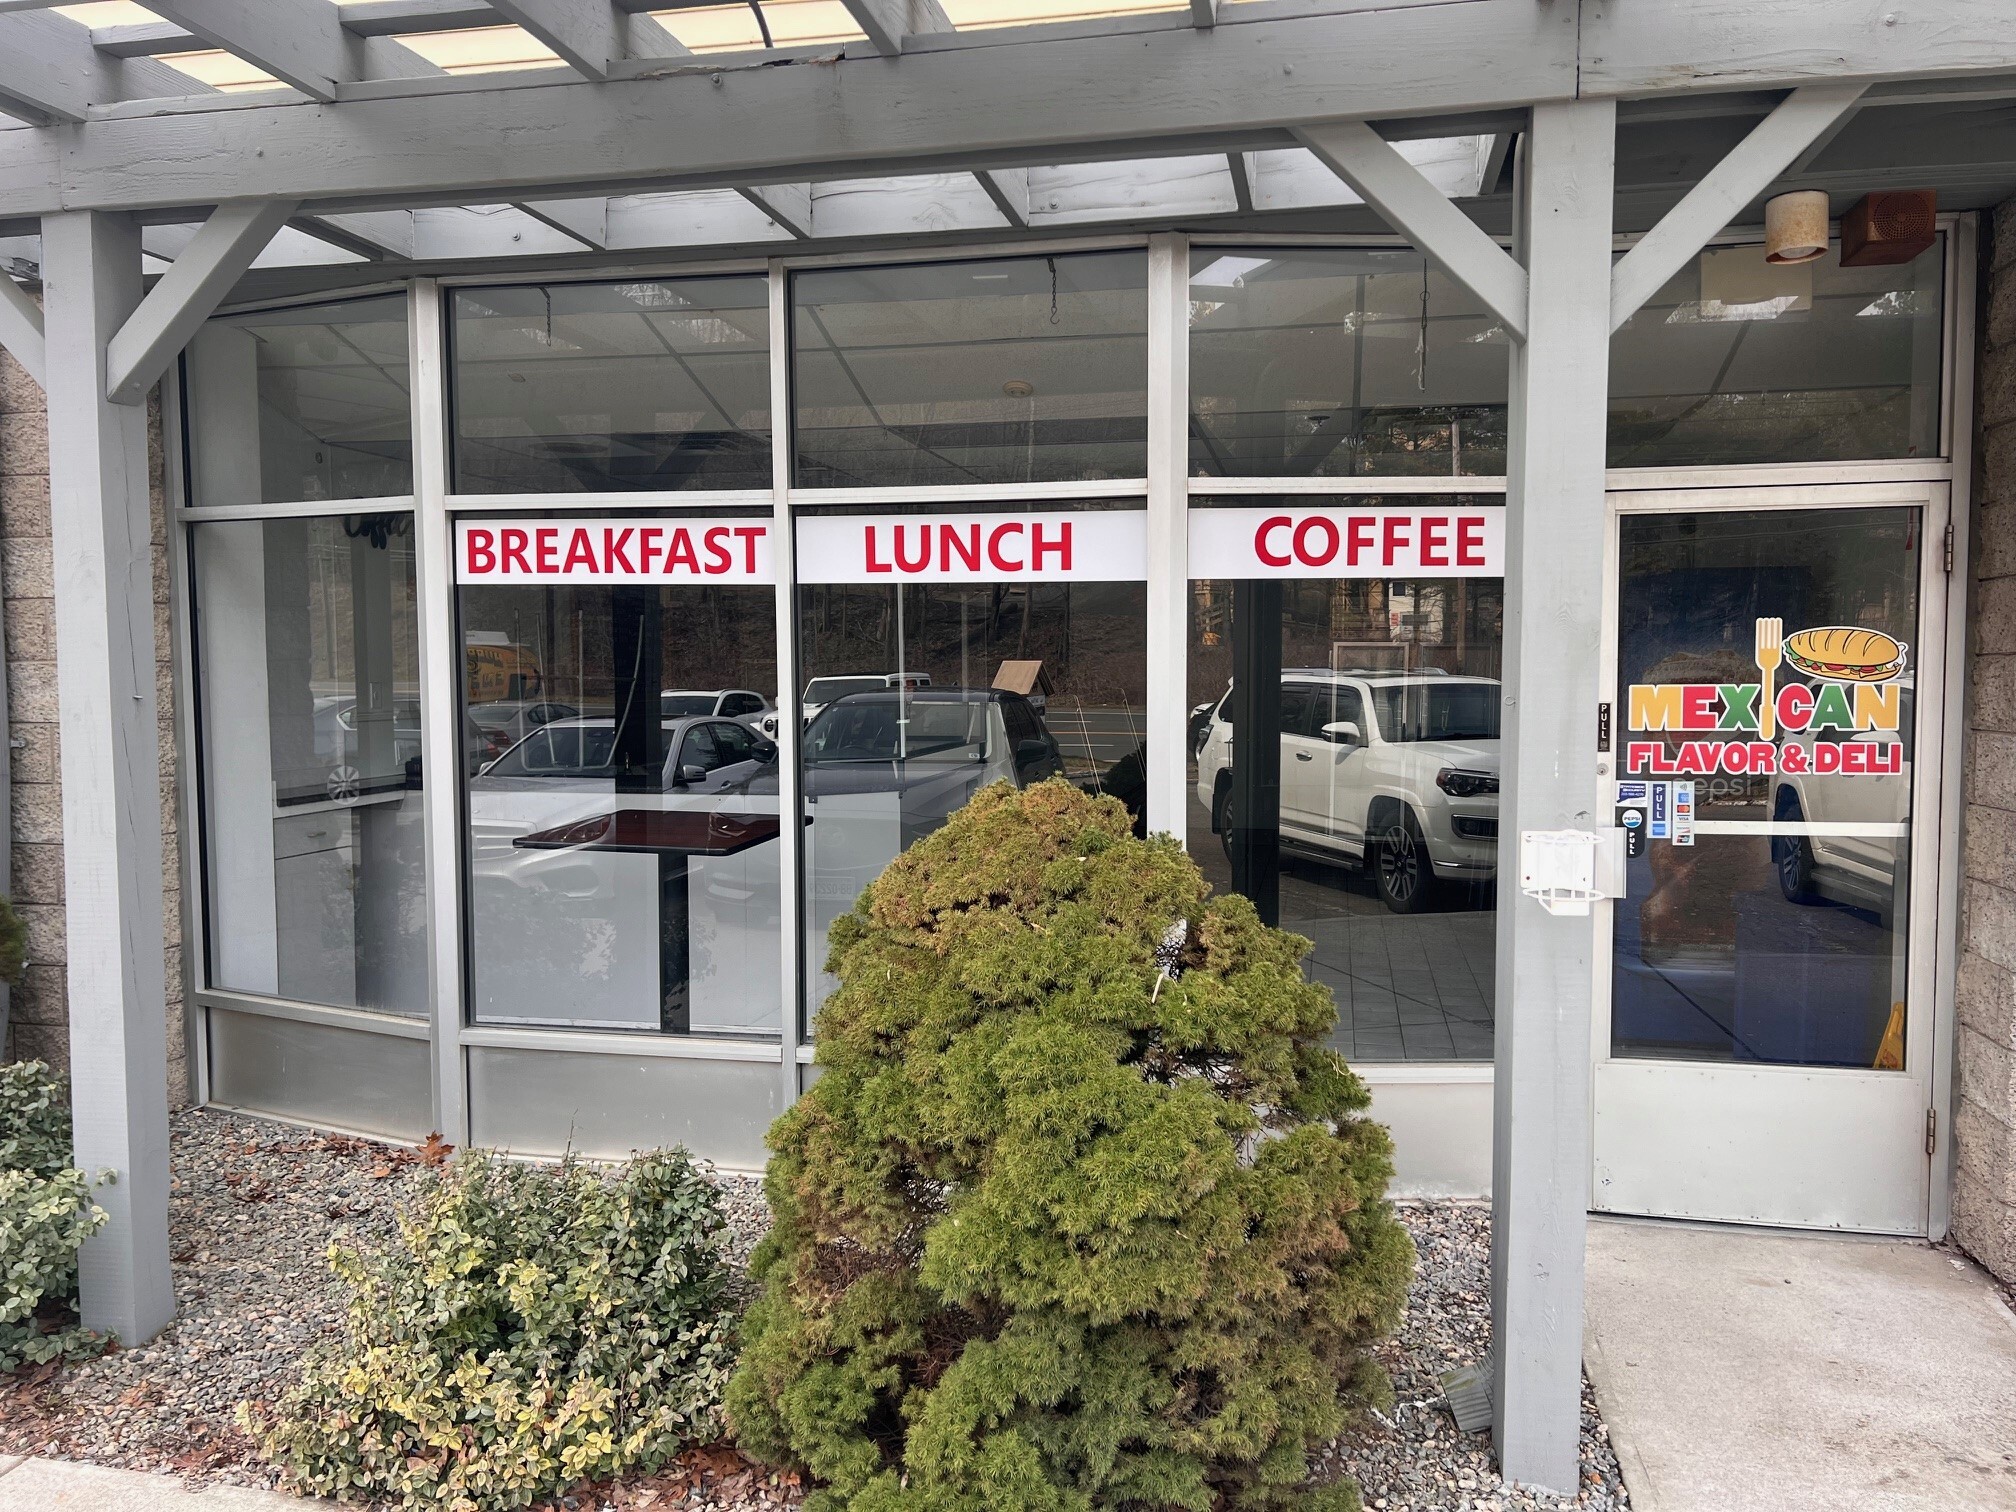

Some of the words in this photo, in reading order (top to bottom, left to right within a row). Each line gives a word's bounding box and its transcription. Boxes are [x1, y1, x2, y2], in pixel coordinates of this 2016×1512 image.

[466, 527, 767, 575] BREAKFAST
[864, 522, 1073, 574] LUNCH
[1254, 515, 1486, 568] COFFEE
[1628, 684, 1901, 732] MEXICAN
[1629, 742, 1776, 774] FLAVOR
[1780, 743, 1809, 774] &
[1813, 742, 1902, 774] DELI
[1673, 774, 1752, 801] epsi
